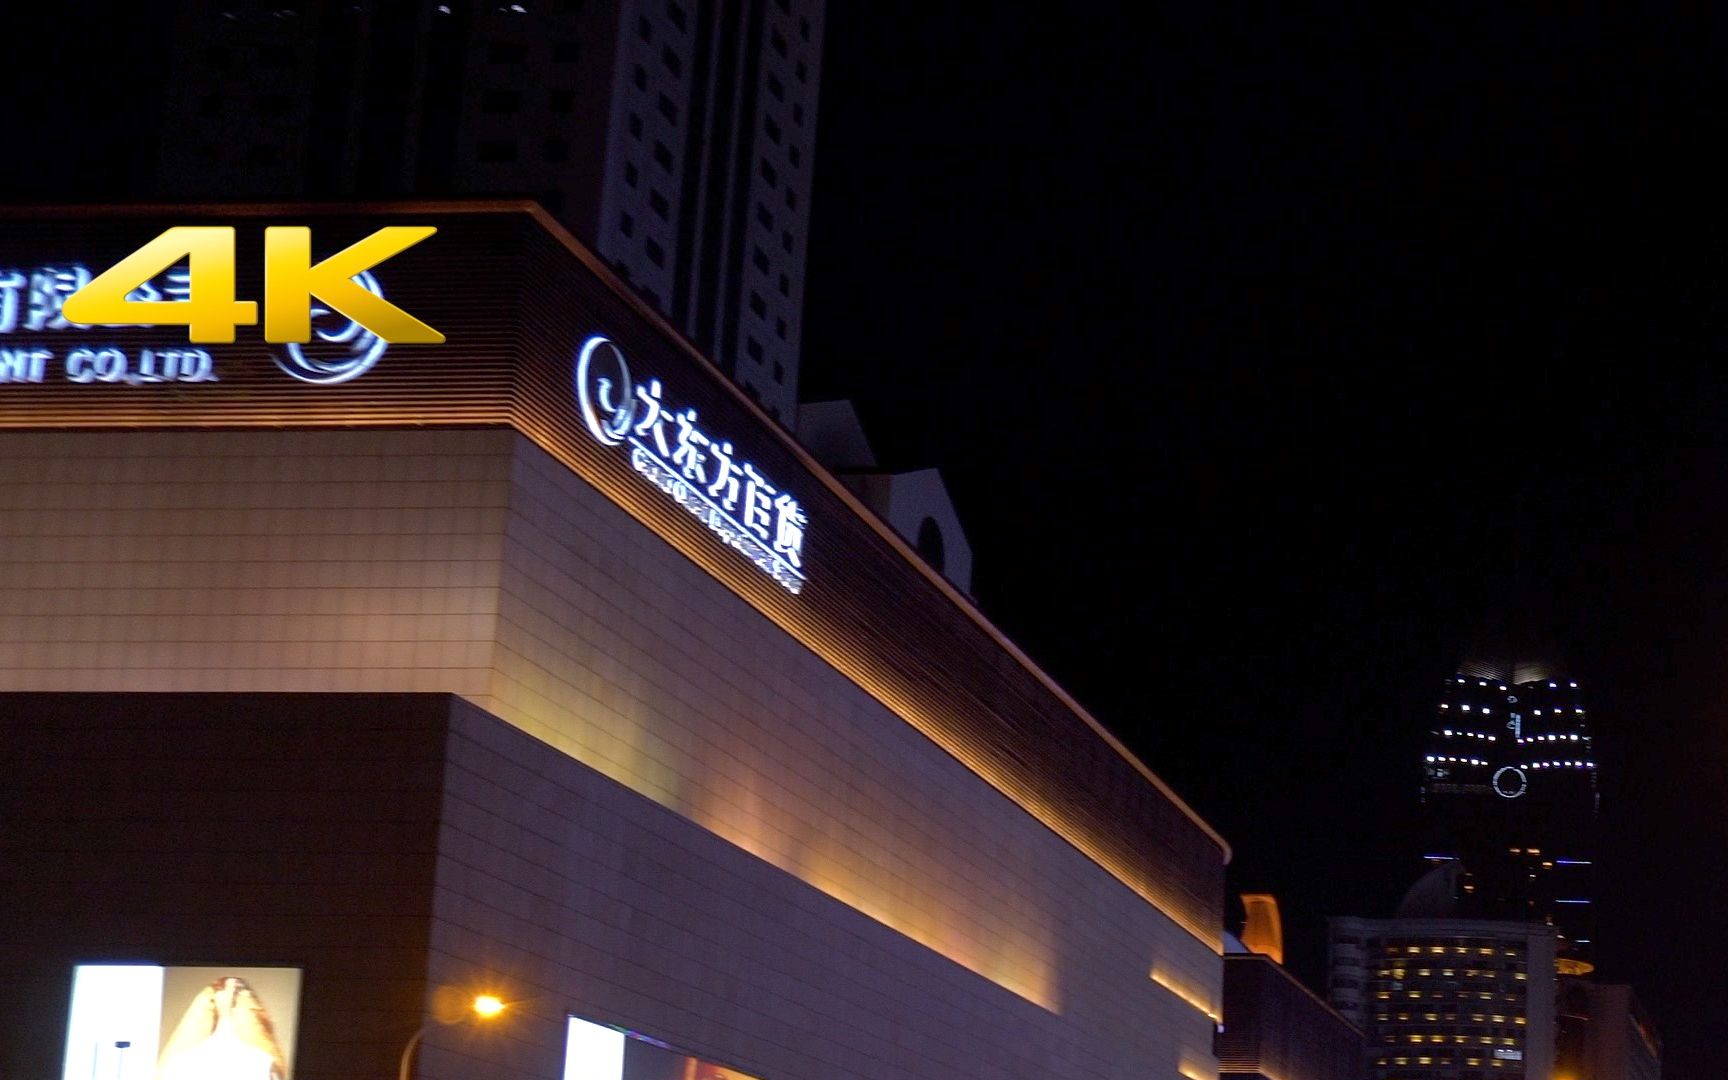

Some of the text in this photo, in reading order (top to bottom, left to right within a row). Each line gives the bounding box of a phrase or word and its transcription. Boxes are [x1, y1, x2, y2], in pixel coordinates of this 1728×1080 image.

[634, 379, 808, 568] 大东方百货
